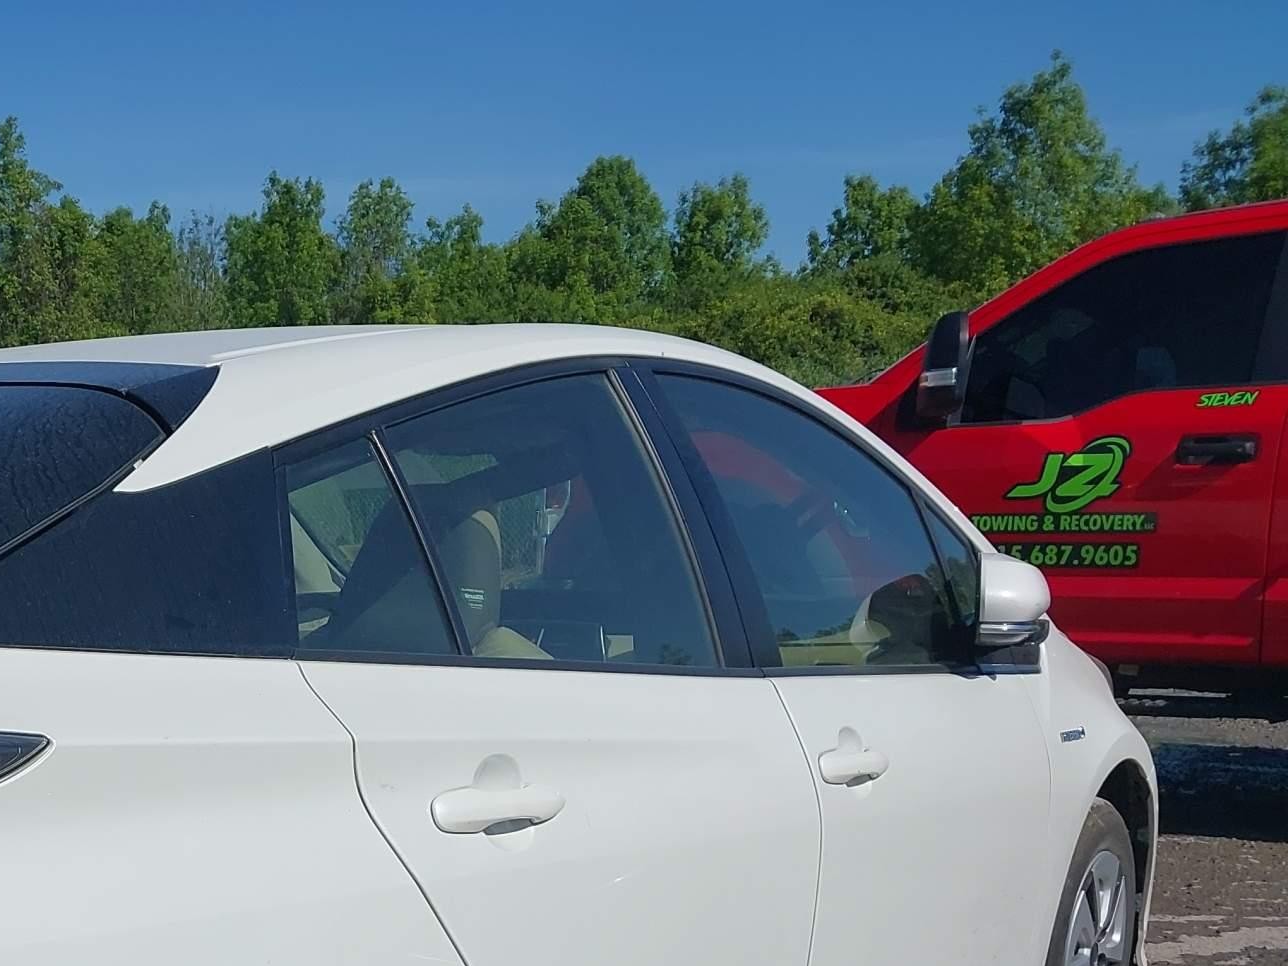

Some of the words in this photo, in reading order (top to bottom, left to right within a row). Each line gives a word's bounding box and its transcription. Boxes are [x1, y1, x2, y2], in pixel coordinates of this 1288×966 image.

[1196, 390, 1260, 407] STEVEN
[972, 515, 1038, 531] TOWING
[1043, 515, 1055, 531] &
[1059, 515, 1145, 531] RECOVERY
